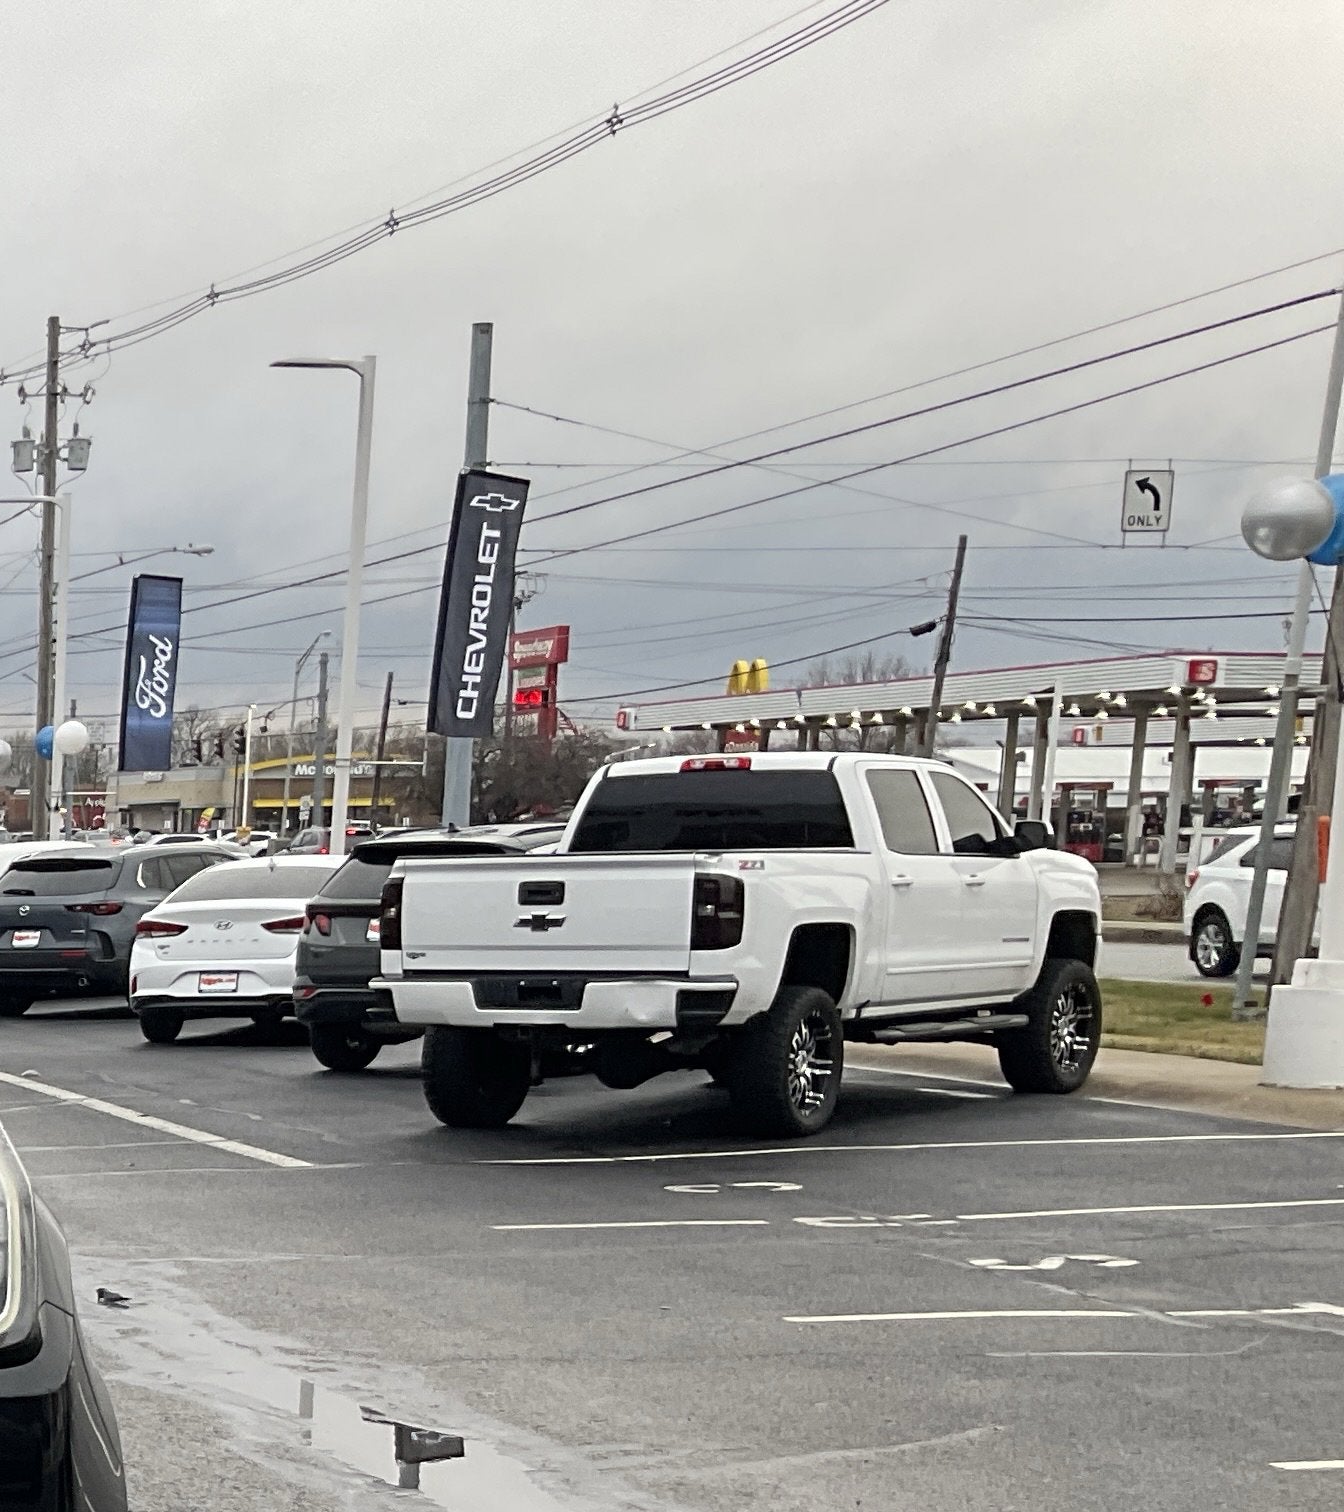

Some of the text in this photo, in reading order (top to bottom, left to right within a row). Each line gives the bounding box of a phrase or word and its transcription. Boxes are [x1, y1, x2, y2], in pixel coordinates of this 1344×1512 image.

[1127, 515, 1162, 527] ONLY
[456, 522, 501, 719] CHEVROLET
[135, 634, 173, 718] Ford
